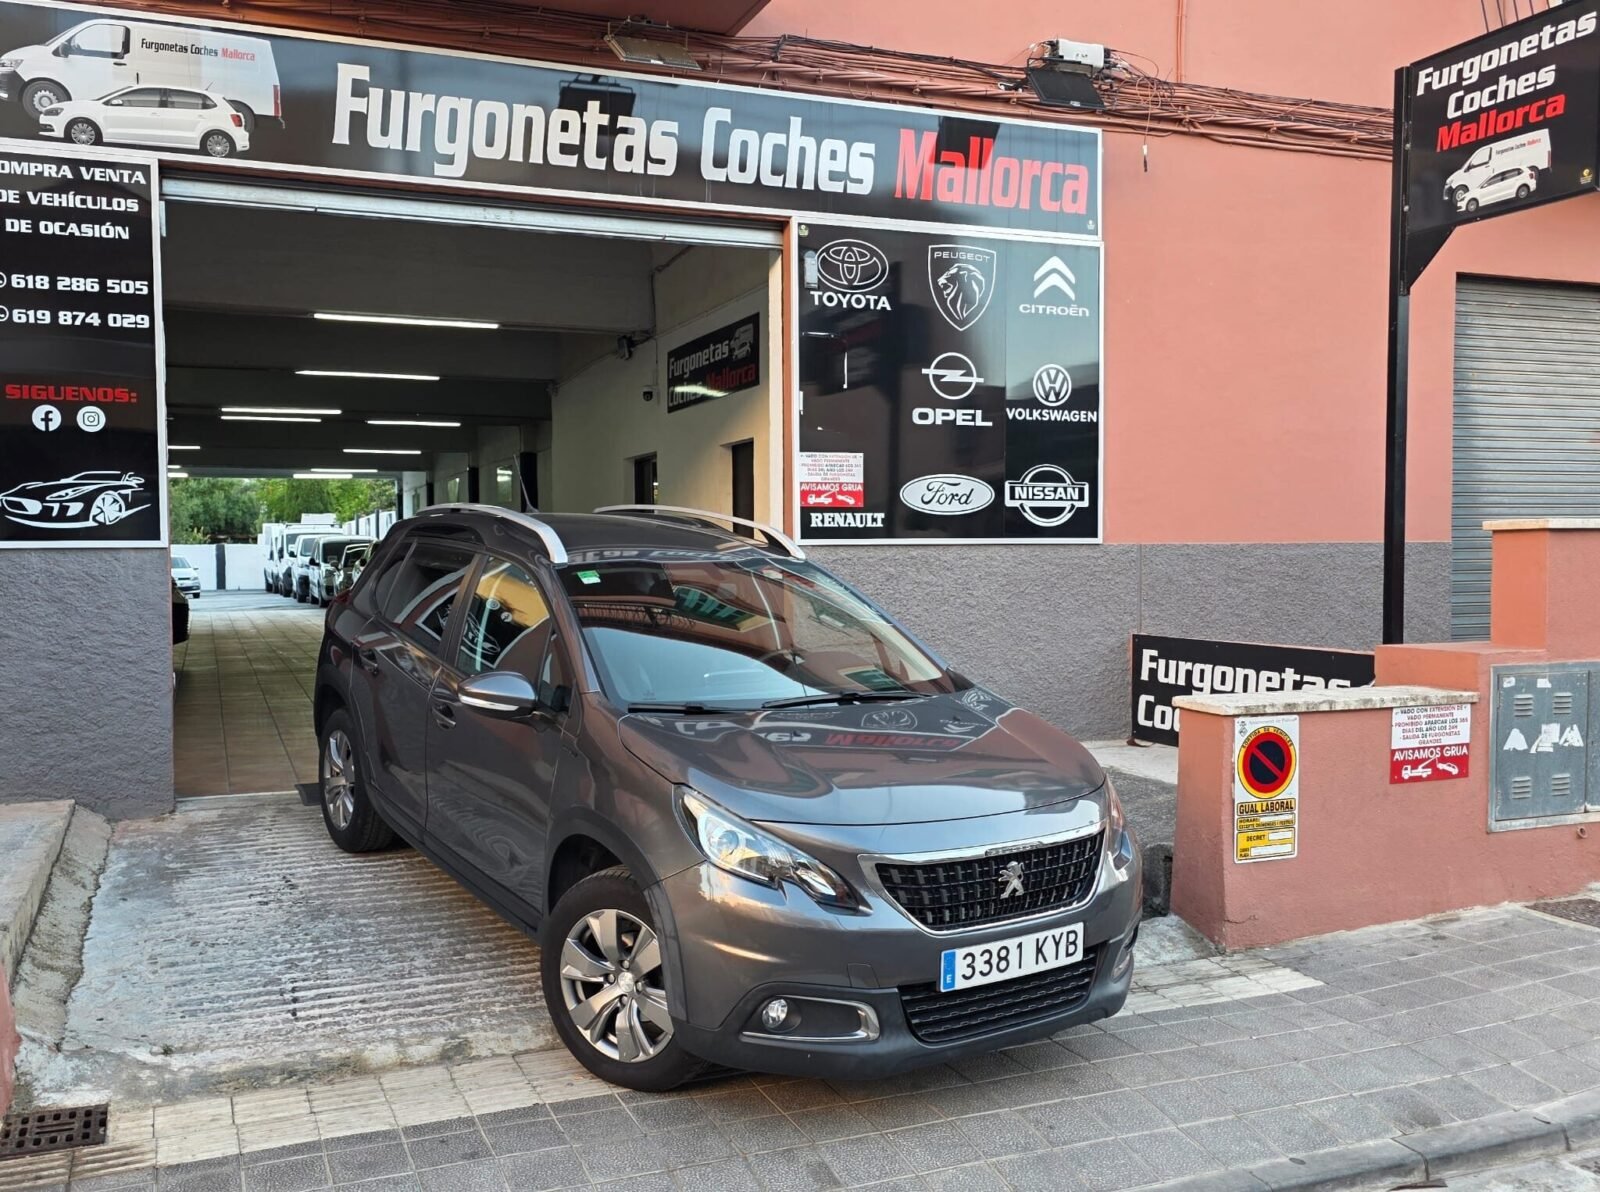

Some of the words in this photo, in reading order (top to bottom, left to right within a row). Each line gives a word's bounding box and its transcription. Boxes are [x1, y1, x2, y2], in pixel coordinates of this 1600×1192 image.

[141, 38, 188, 54] Furgonetas
[190, 43, 218, 57] Coches
[221, 47, 255, 61] Mallorca
[1416, 11, 1597, 96] Furgonetas
[1446, 64, 1556, 119] Coches
[1436, 93, 1566, 152] Mallorca
[332, 62, 678, 178] Furgonetas
[700, 106, 876, 195] Coches
[894, 127, 1089, 215] Mallorca
[0, 160, 74, 179] OMPRA
[79, 166, 147, 184] VENTA
[26, 191, 139, 212] VEHÍCULOS
[5, 218, 33, 234] DE
[39, 222, 130, 240] OCASIÓN
[934, 251, 991, 263] PEUGEOT
[11, 273, 50, 290] 618
[56, 276, 100, 292] 286
[106, 279, 149, 295] 505
[809, 290, 892, 311] TOYOTA
[12, 308, 51, 324] 619
[58, 310, 101, 327] 874
[107, 313, 150, 329] 029
[669, 340, 729, 379] Furgonetas
[5, 384, 137, 403] SIGUENOS:
[912, 407, 993, 427] OPEL
[1006, 407, 1097, 423] VOLKSWAGEN
[921, 480, 975, 505] Ford
[1014, 486, 1079, 500] NISSAN
[810, 512, 885, 528] RENAULT
[1393, 747, 1441, 761] AVISAMOS
[1442, 745, 1469, 757] GRUA
[1239, 803, 1259, 815] GUAL
[1260, 800, 1294, 813] LABORAL
[961, 941, 1023, 980] 3381
[1035, 929, 1079, 966] KYB
